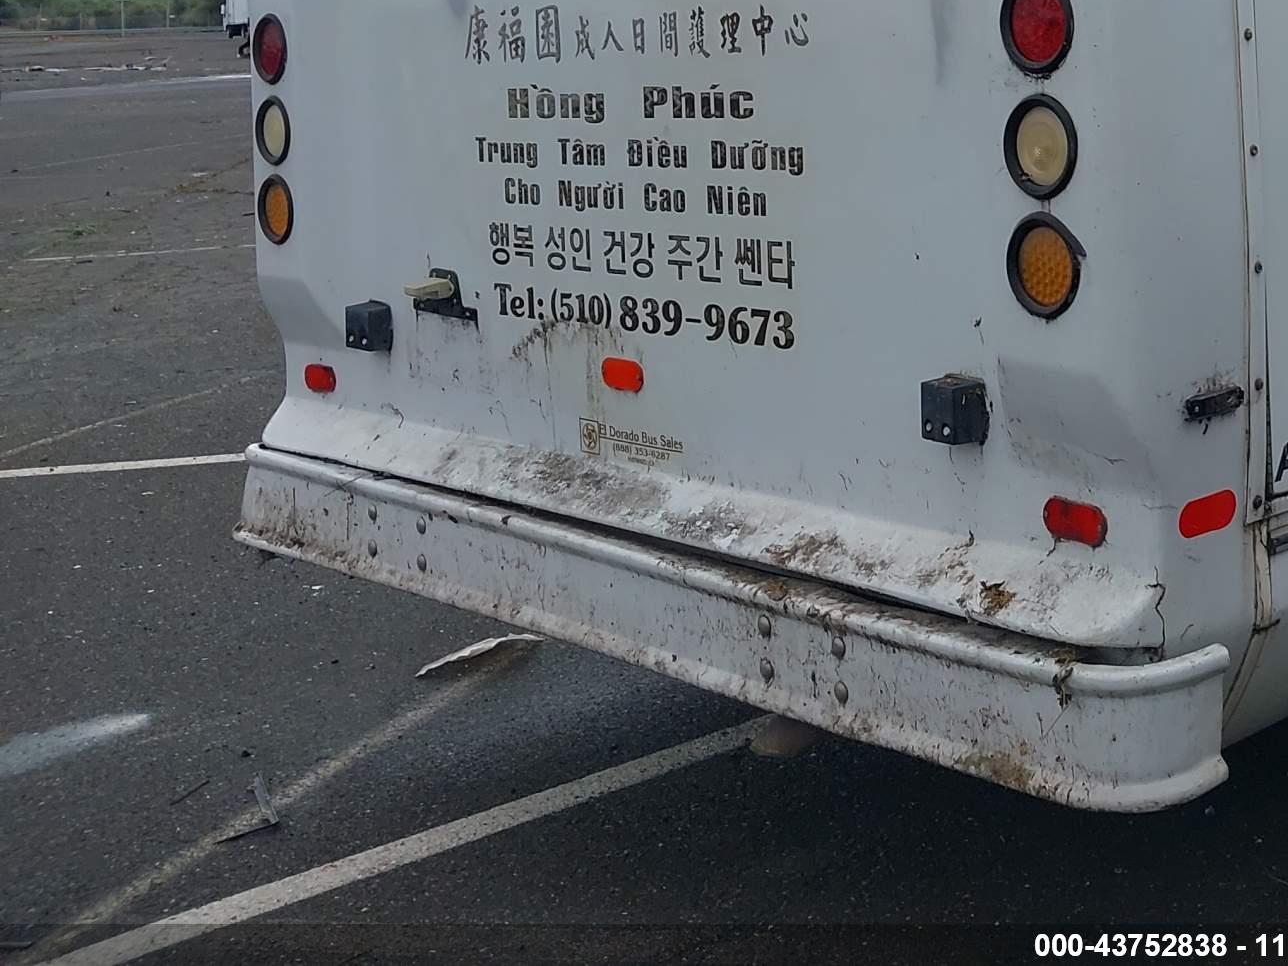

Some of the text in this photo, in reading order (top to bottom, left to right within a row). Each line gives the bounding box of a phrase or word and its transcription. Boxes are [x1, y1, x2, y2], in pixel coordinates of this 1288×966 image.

[507, 84, 754, 123] Hồng Phúc
[475, 136, 804, 176] Trung Tâm Điều Dưỡng
[504, 177, 767, 216] Cho Người Cao Niên
[489, 222, 796, 289] 행복 성인 건강 주간 쎈타
[620, 295, 796, 349] 839-9673
[609, 426, 640, 442] Dorado
[642, 432, 658, 445] Bus
[660, 435, 684, 450] Sales
